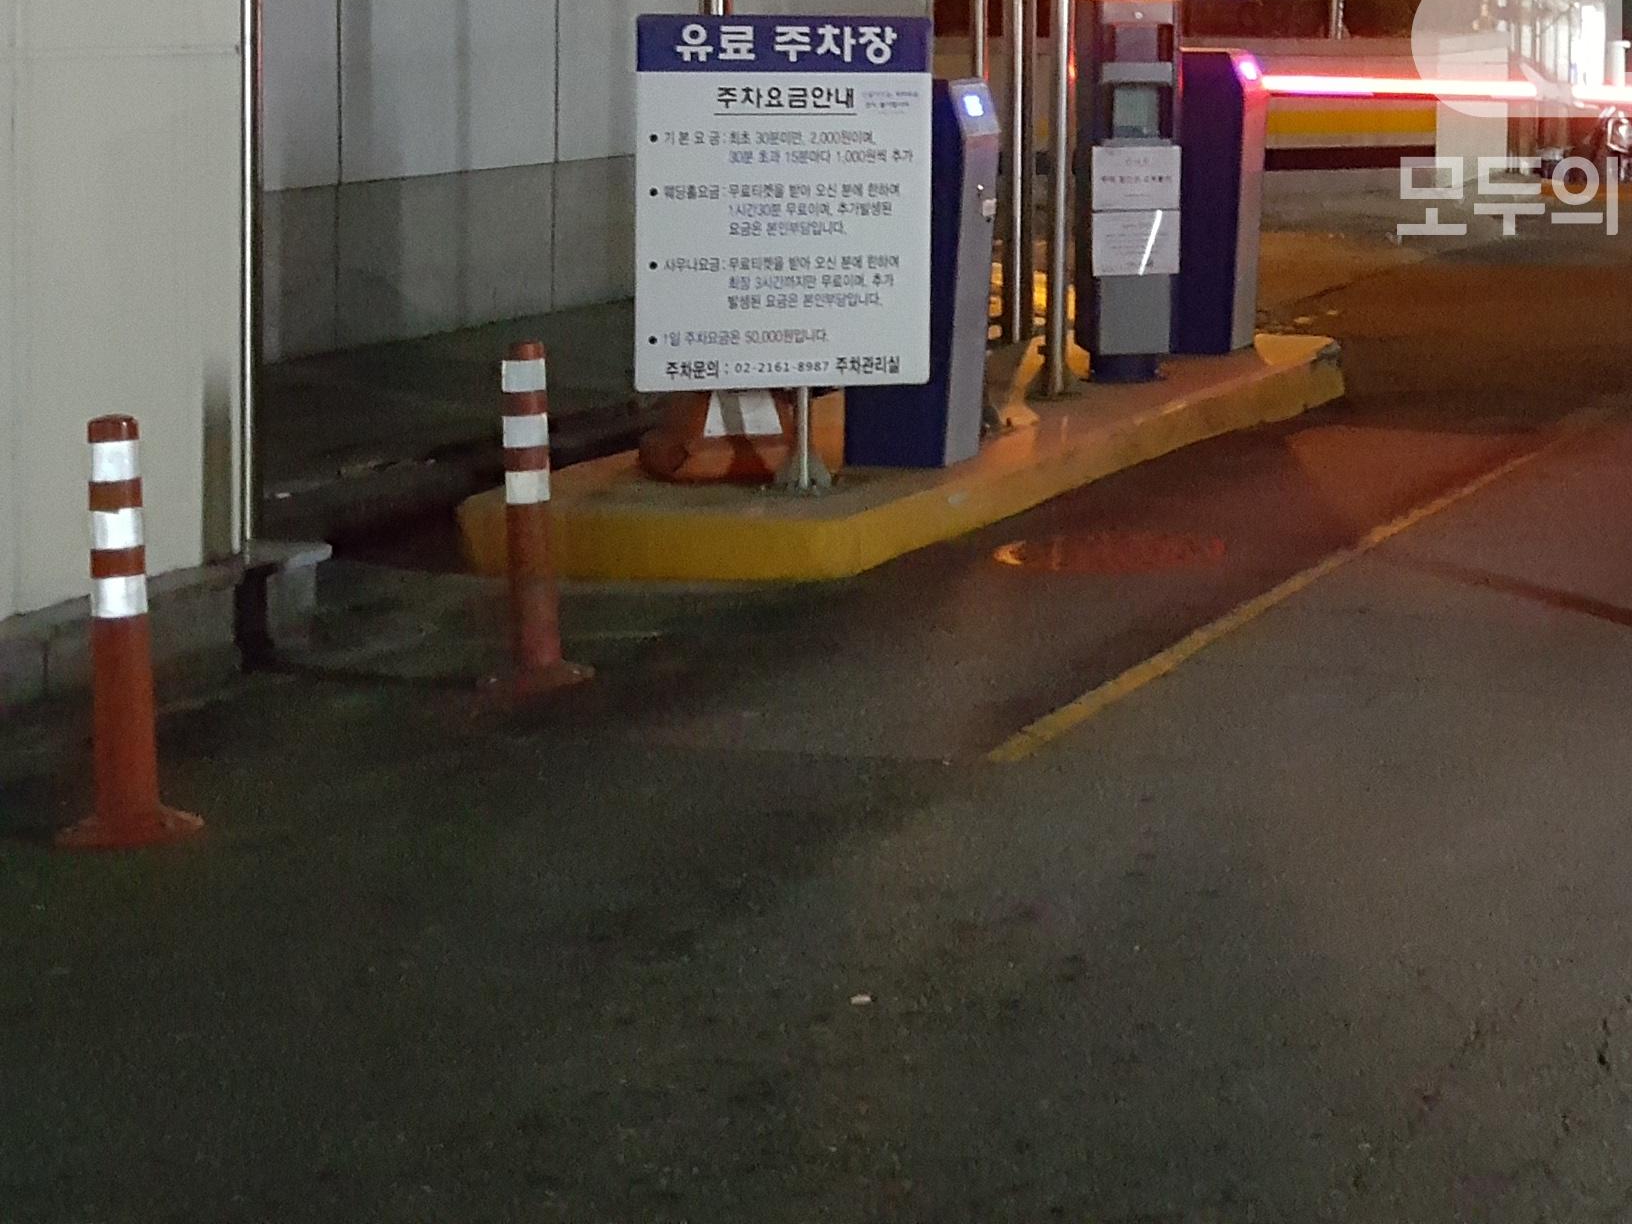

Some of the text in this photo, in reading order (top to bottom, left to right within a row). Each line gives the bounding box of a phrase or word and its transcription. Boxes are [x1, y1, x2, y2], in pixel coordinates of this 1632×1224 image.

[675, 22, 898, 65] 유료 주차장
[716, 85, 855, 109] 주차요금안내
[891, 147, 914, 163] 추가
[815, 182, 838, 198] 오신
[728, 221, 763, 237] 요금은
[815, 255, 837, 270] 오신
[872, 272, 895, 288] 추가
[765, 292, 799, 309] 요금은
[684, 329, 741, 346] 주차요금은
[665, 360, 720, 379] 주차문의
[834, 355, 901, 374] 주차관리실
